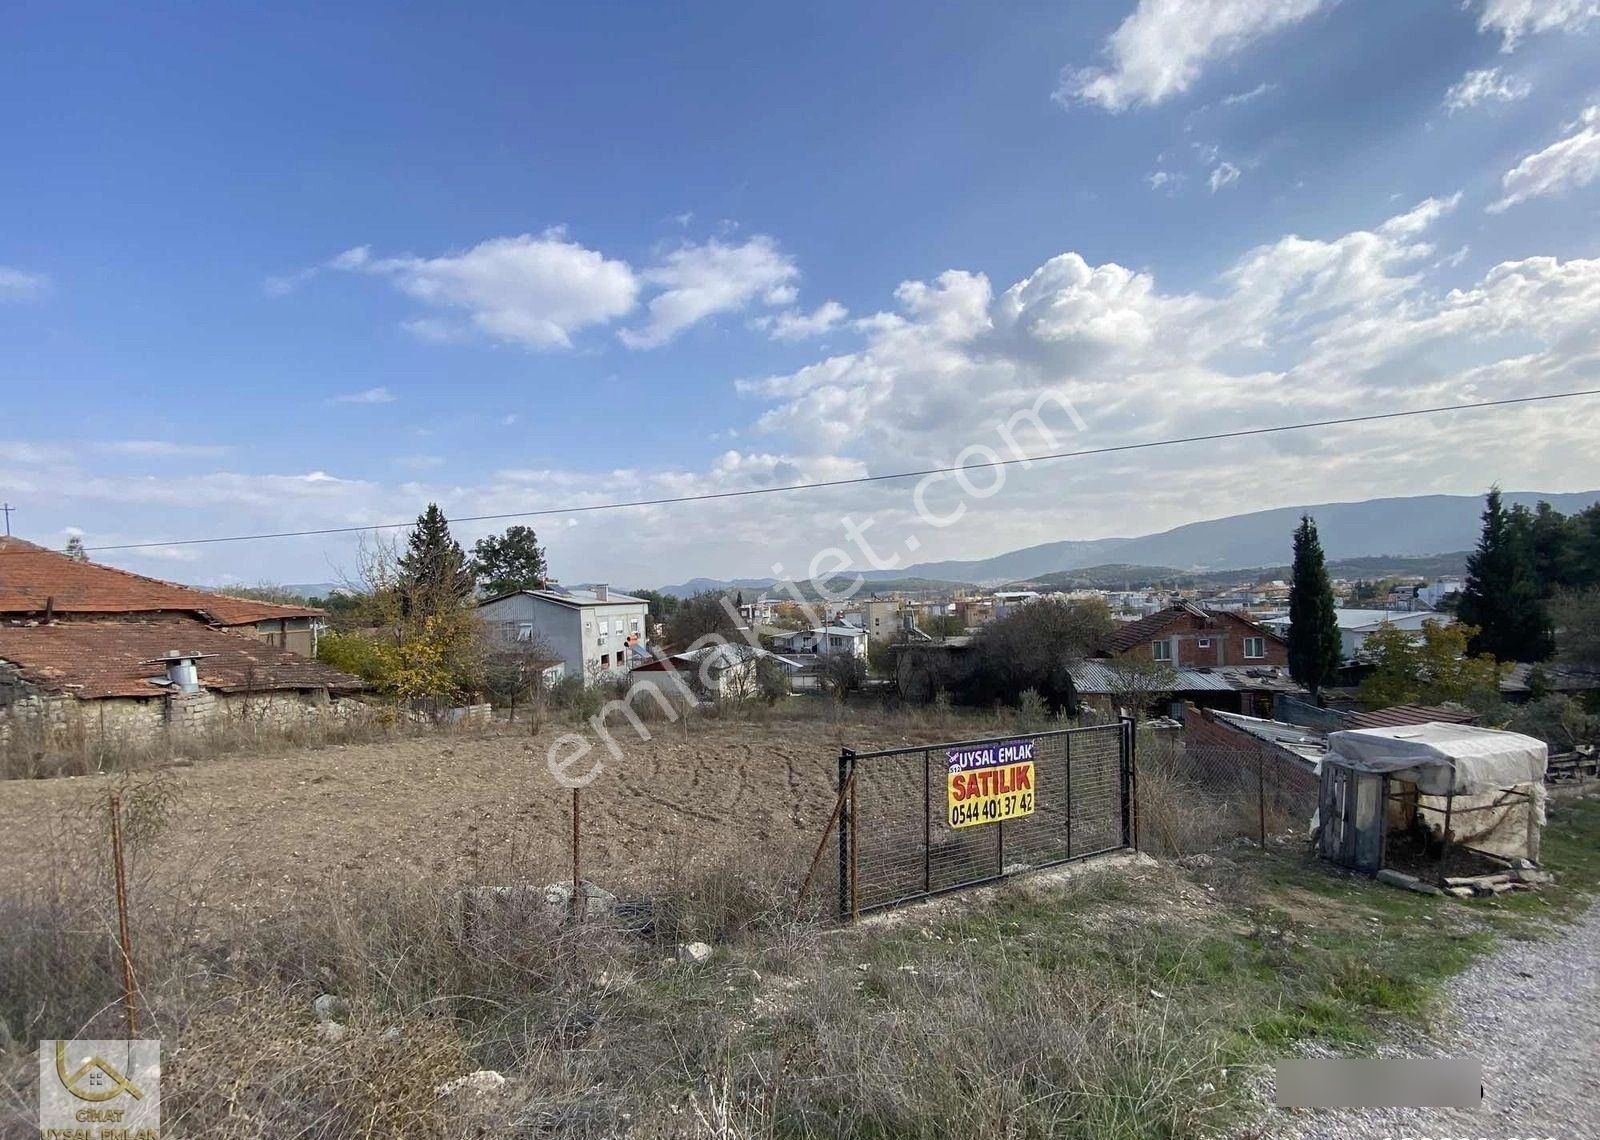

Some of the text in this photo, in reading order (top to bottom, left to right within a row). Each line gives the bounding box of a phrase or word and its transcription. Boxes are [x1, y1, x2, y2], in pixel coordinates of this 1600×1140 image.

[960, 749, 997, 768] UYSAL
[998, 744, 1032, 763] EMLAK
[952, 765, 1031, 802] SATILIK
[952, 793, 1032, 825] 0544 401 37 42
